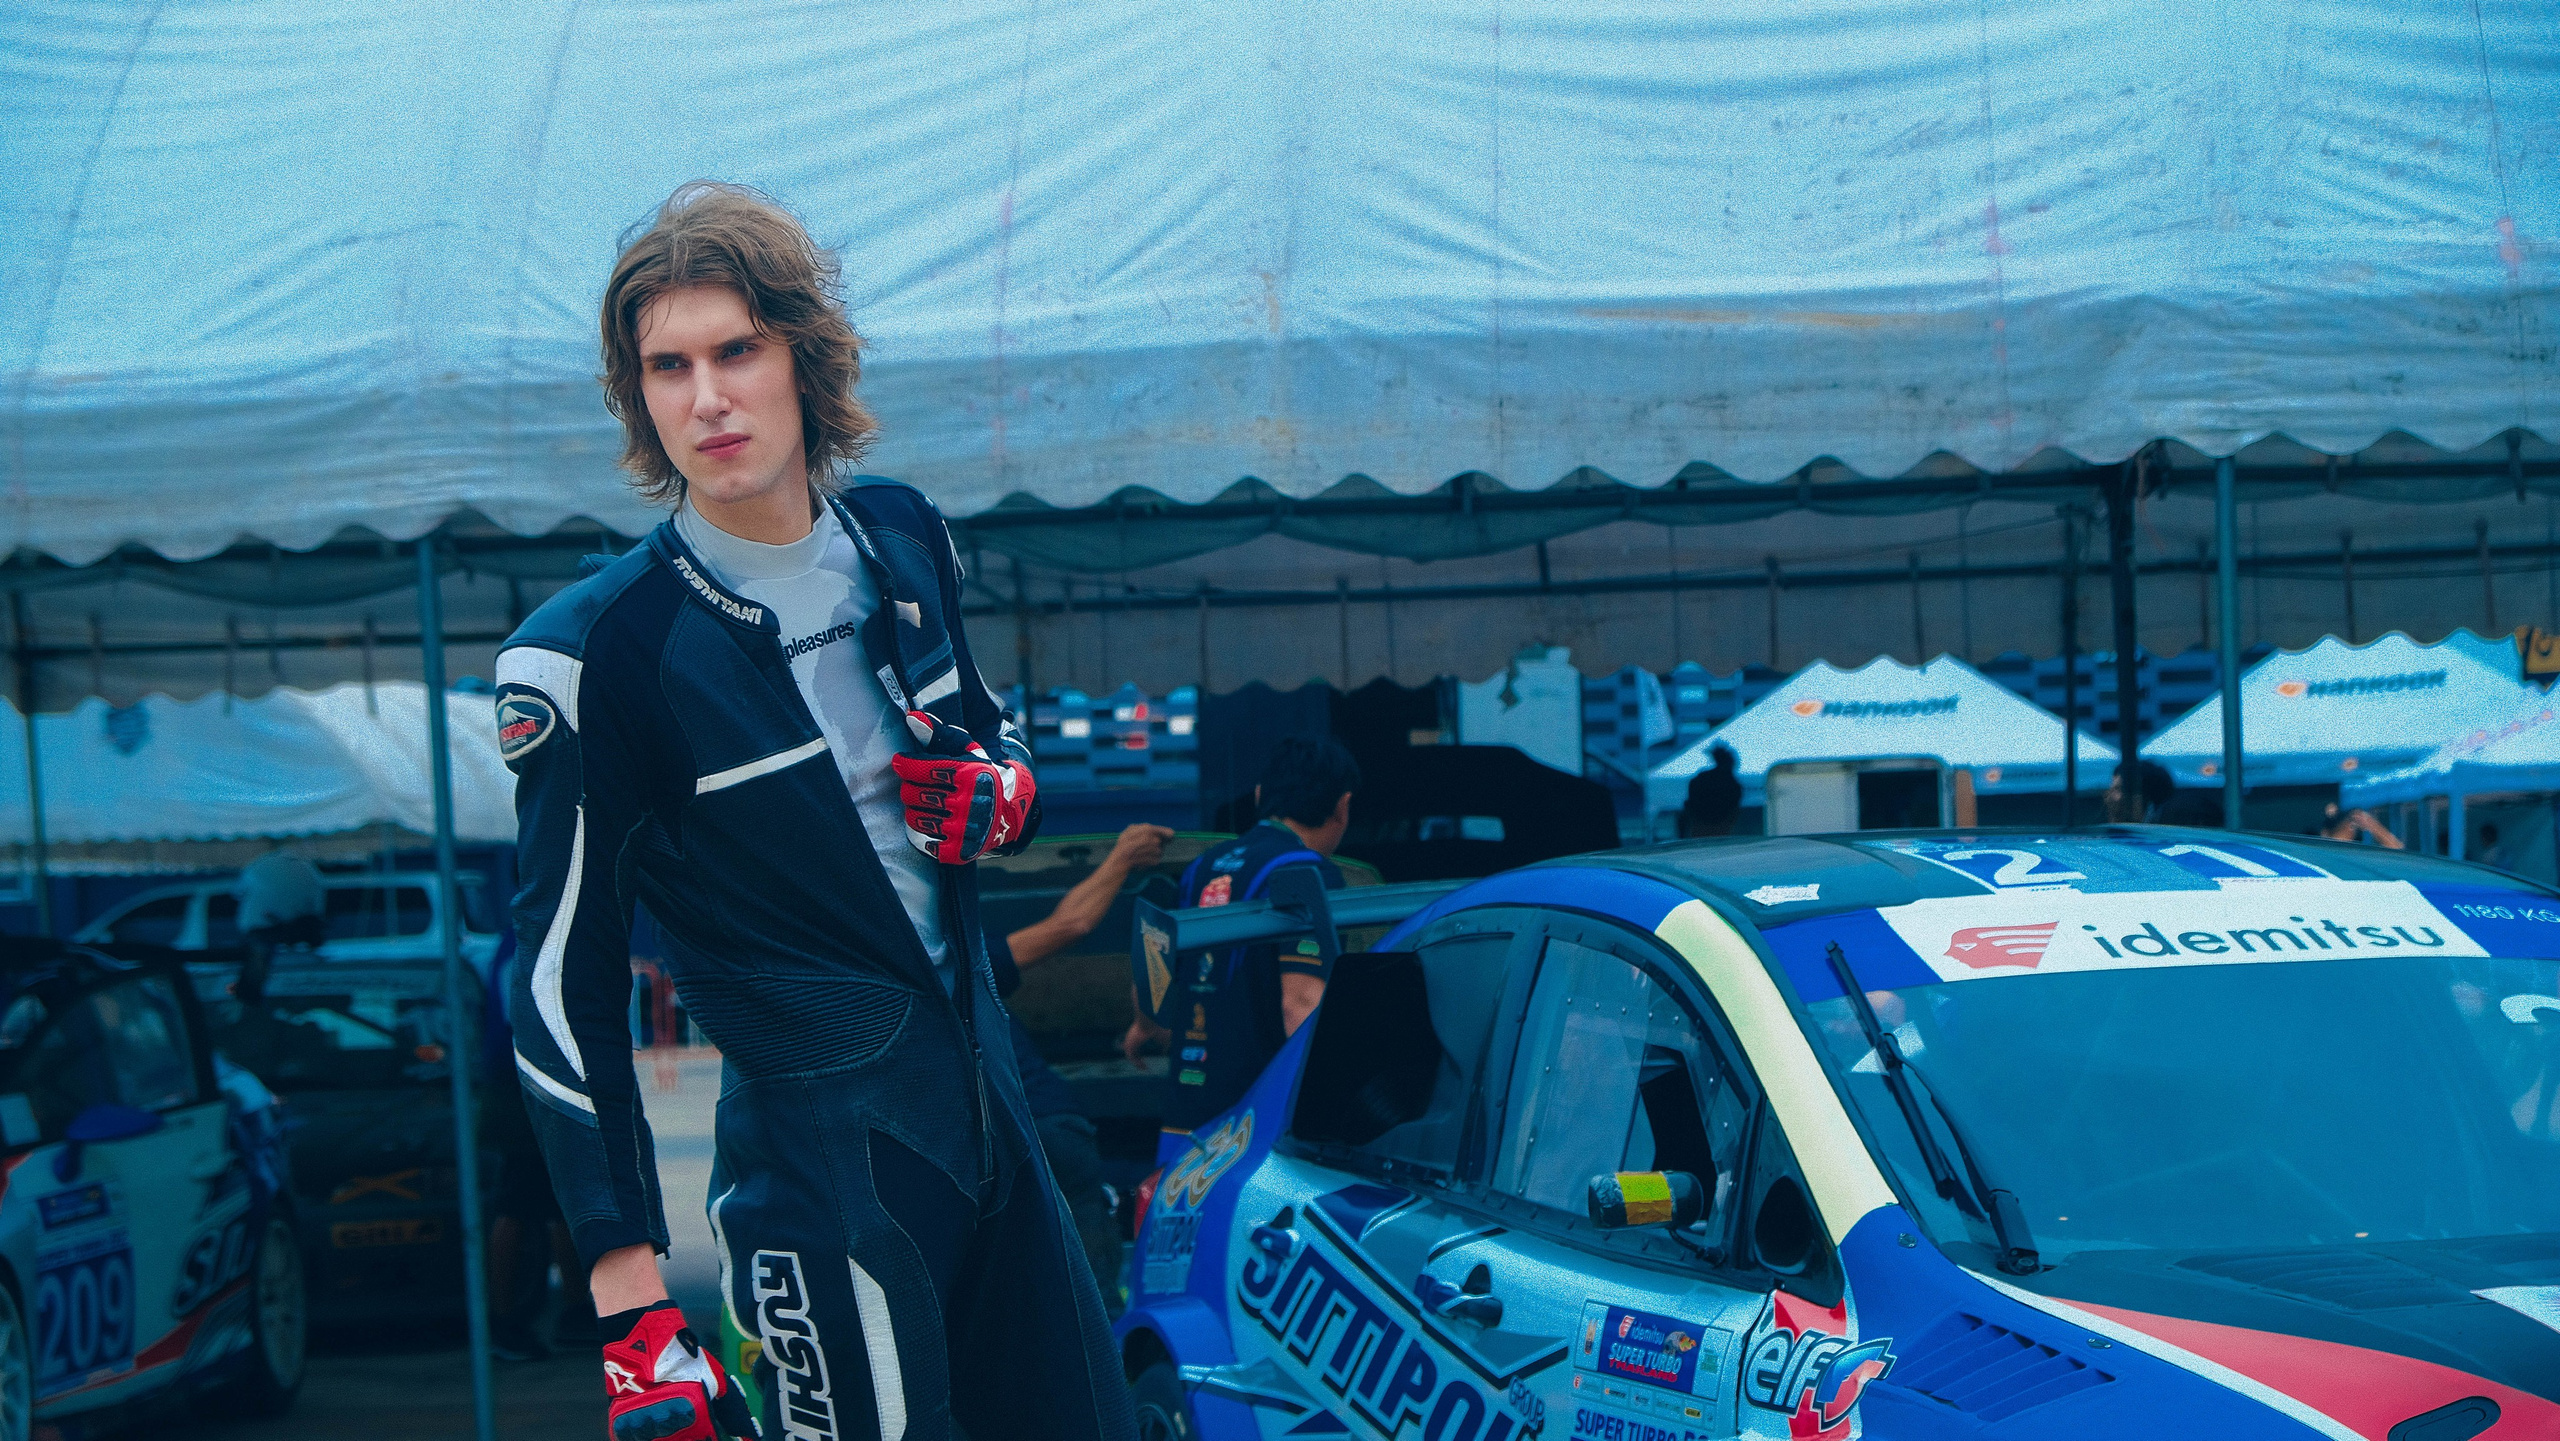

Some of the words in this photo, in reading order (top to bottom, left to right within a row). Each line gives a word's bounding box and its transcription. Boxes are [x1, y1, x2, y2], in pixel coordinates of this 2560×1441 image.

[783, 621, 856, 664] pleasures
[1943, 849, 2087, 886] 2
[2158, 844, 2280, 878] 1
[2452, 903, 2515, 920] 1180
[2081, 916, 2447, 959] idemitsu
[36, 1254, 131, 1378] 209
[751, 1249, 839, 1441] KUSHI
[1609, 1342, 1646, 1370] SUPER
[1646, 1349, 1683, 1375] TURBO
[1745, 1329, 1853, 1415] elf
[1575, 1408, 1624, 1441] SUPER
